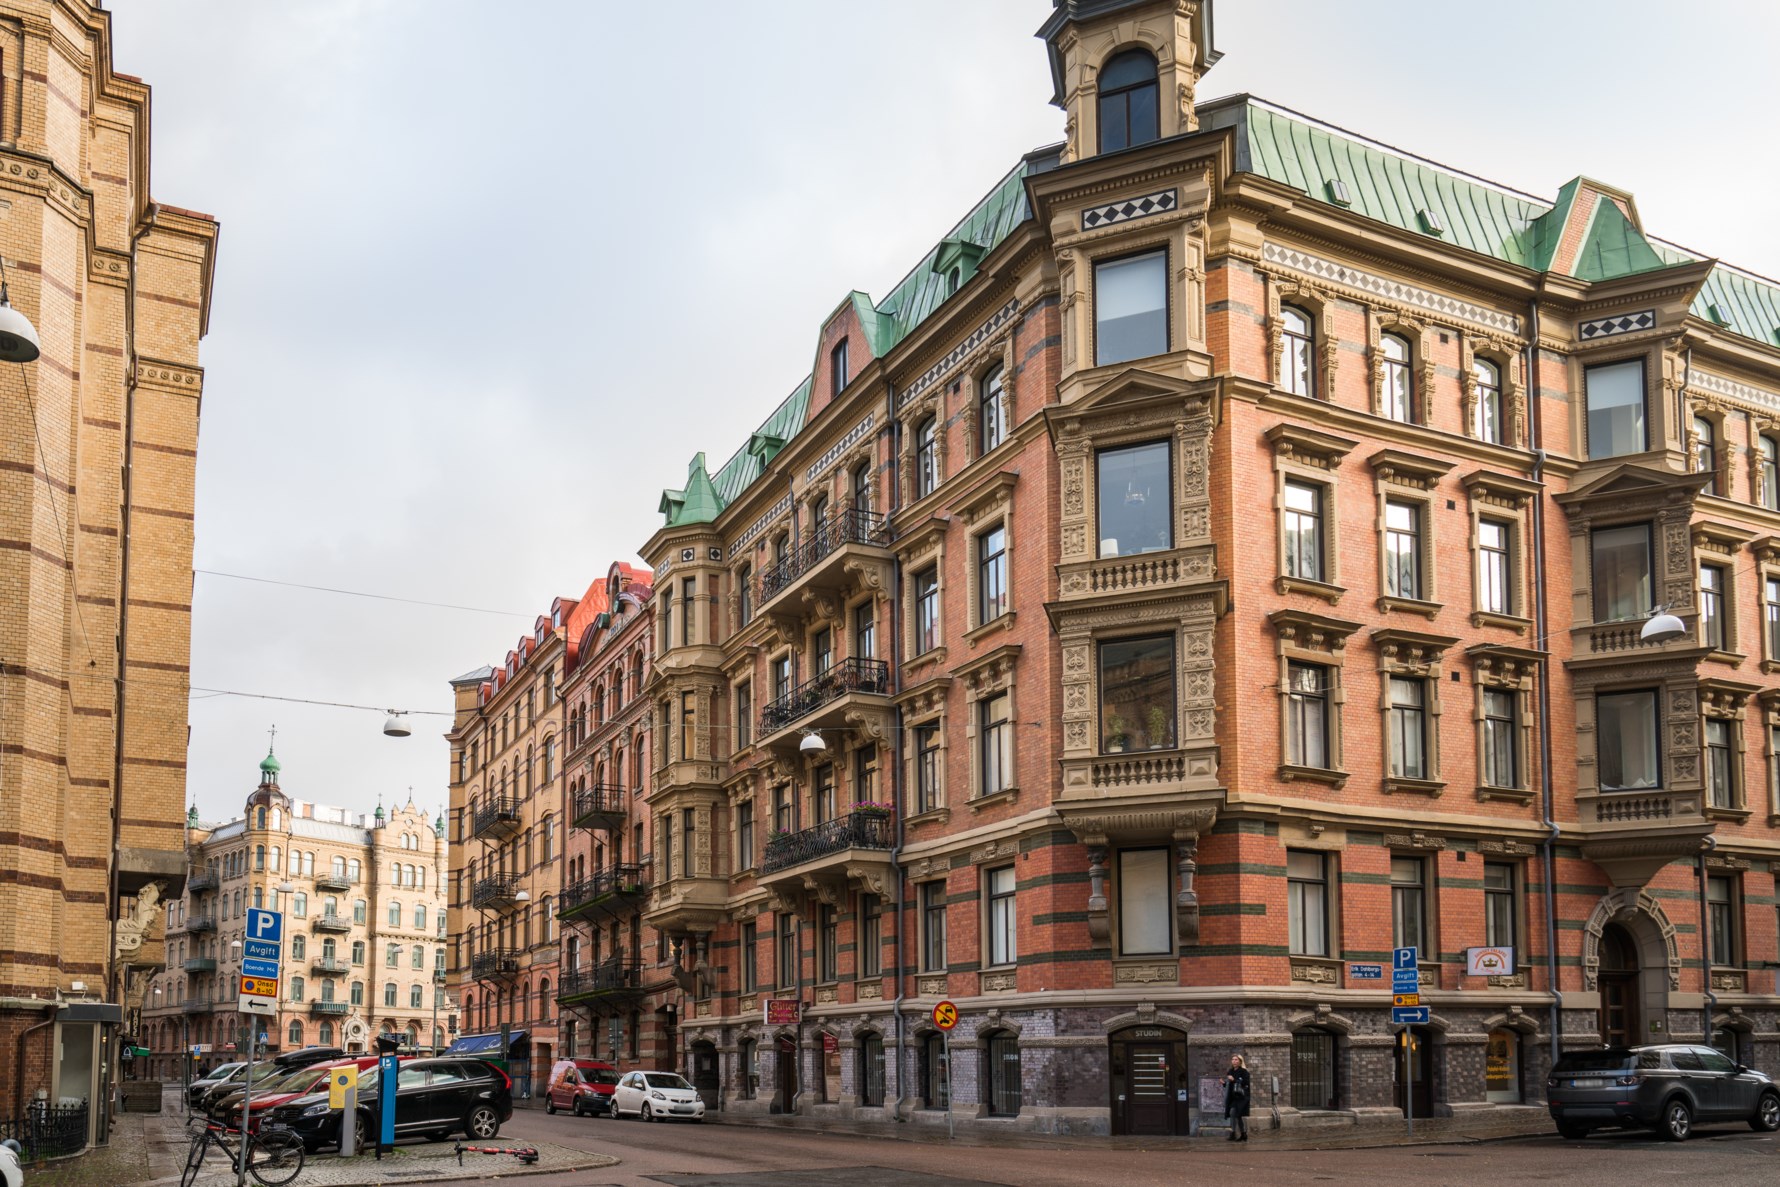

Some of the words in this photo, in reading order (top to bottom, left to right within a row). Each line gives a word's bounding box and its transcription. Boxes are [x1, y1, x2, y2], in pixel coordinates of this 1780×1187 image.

[257, 912, 274, 937] P
[250, 945, 275, 956] Avgift
[1400, 951, 1411, 967] P
[245, 963, 264, 971] Boende
[1396, 972, 1415, 980] Avgift
